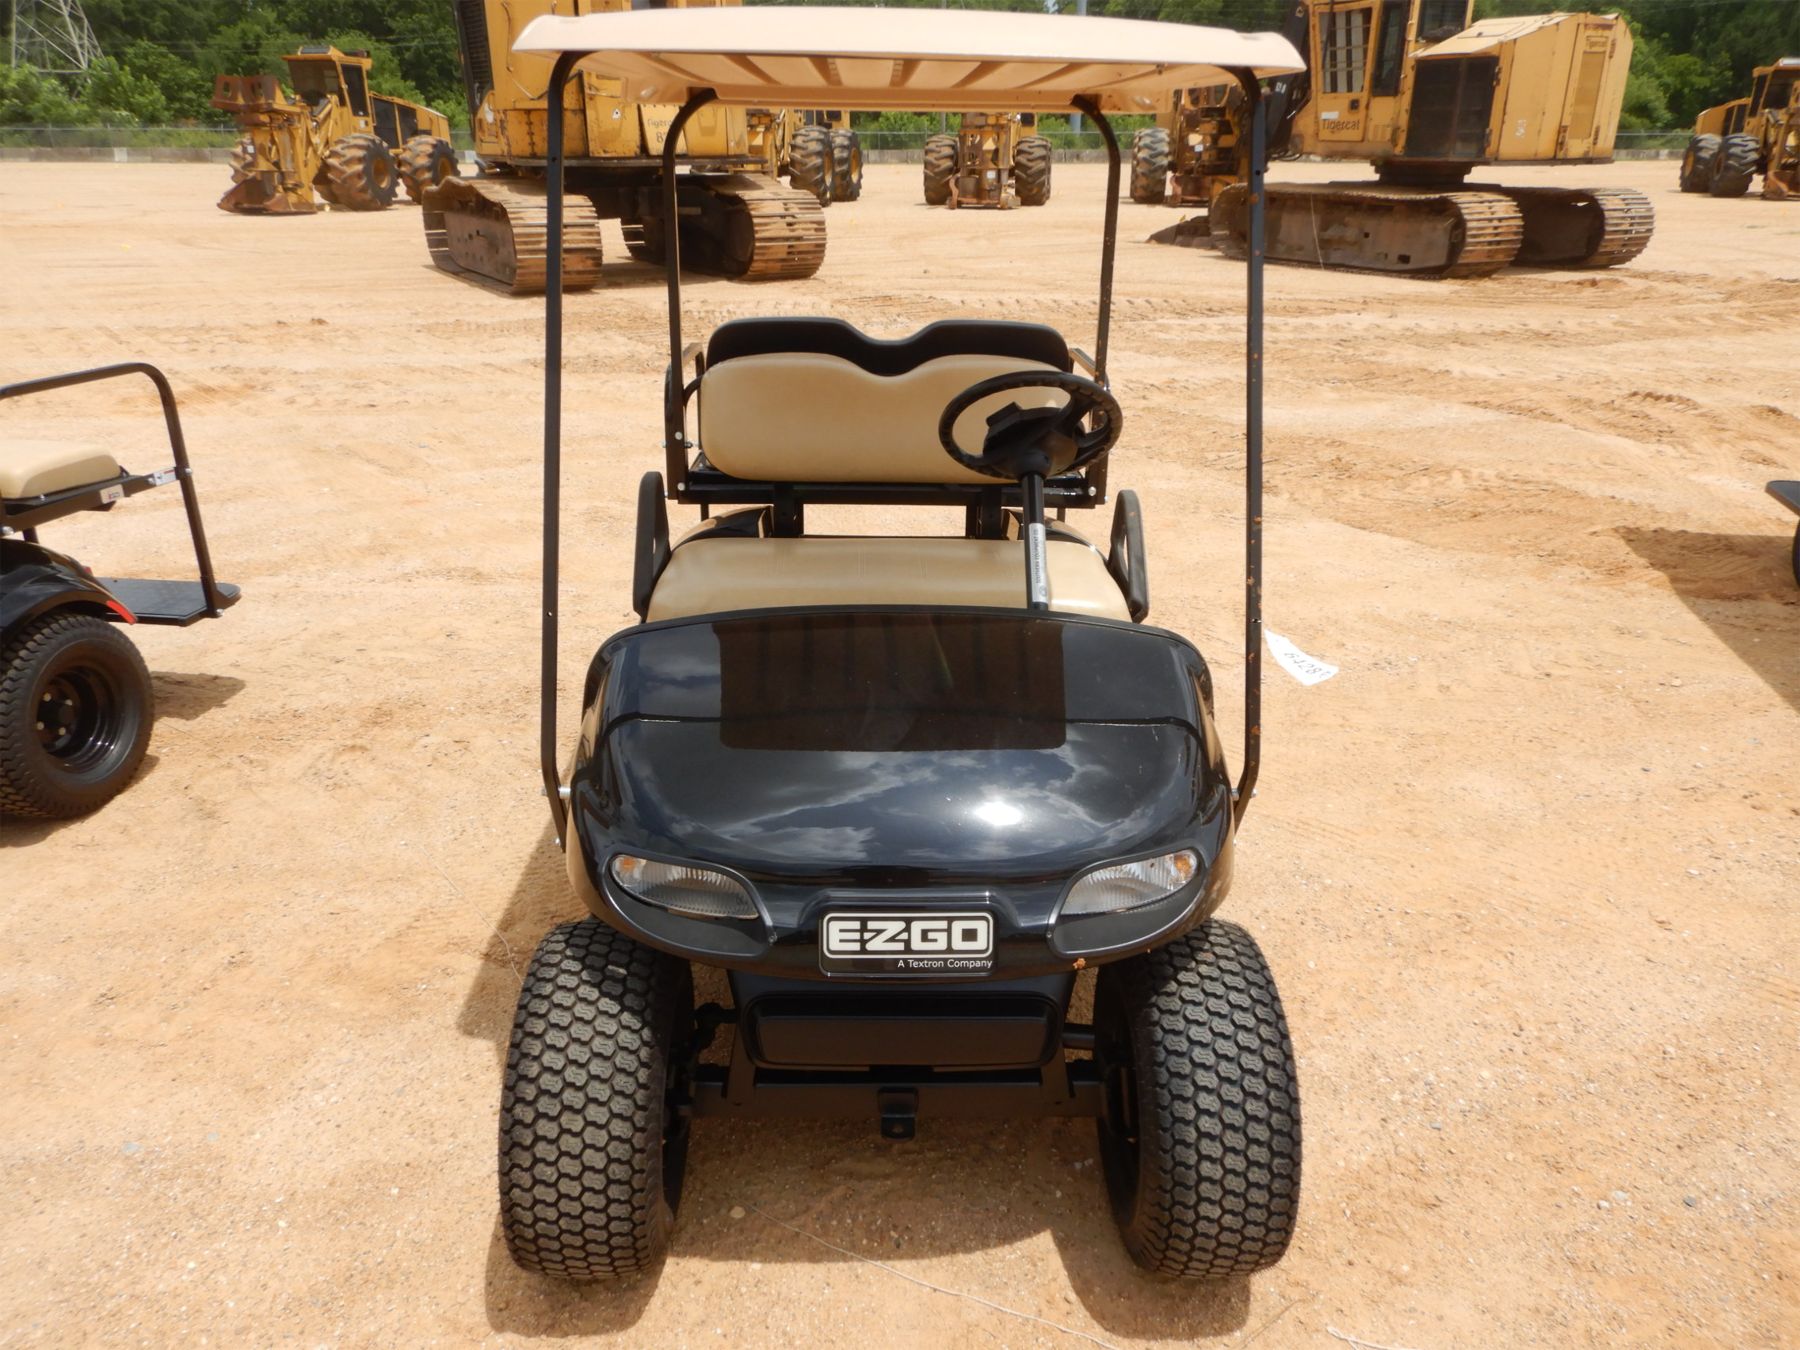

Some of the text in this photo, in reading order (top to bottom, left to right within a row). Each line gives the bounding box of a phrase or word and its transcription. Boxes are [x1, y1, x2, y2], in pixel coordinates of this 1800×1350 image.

[1322, 119, 1361, 132] Tigercat
[897, 959, 993, 969] A Textron Company
